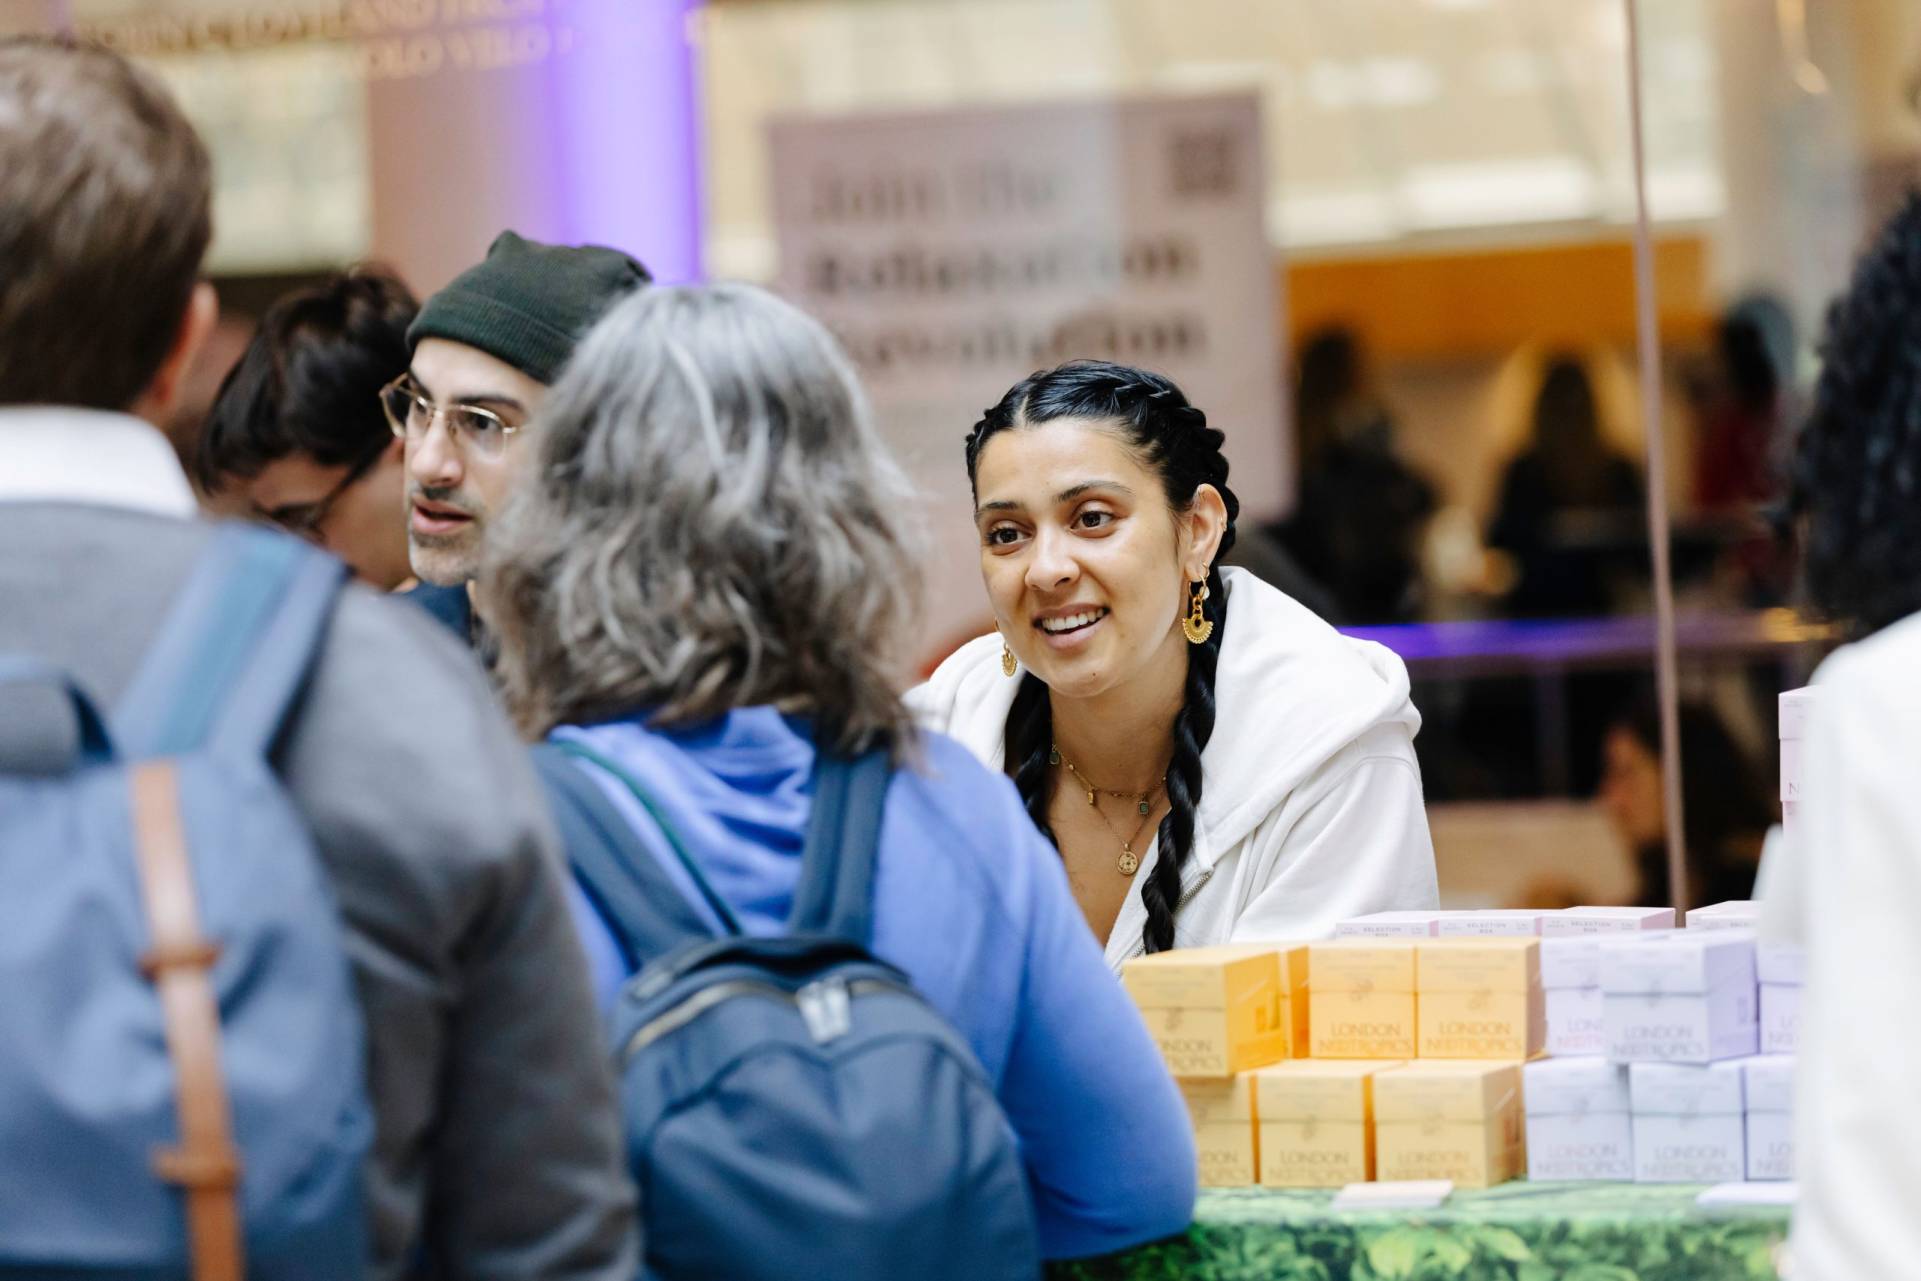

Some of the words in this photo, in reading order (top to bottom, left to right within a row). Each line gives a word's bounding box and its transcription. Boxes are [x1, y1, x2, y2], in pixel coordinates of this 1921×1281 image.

[1330, 1022, 1401, 1037] LONDON
[1439, 1021, 1511, 1036] LONDON
[1624, 1024, 1693, 1039] LONDON
[1280, 1151, 1349, 1165] LONDON
[1396, 1151, 1471, 1165] LONDON
[1547, 1143, 1618, 1158] LONDON
[1653, 1144, 1728, 1159] LONDON
